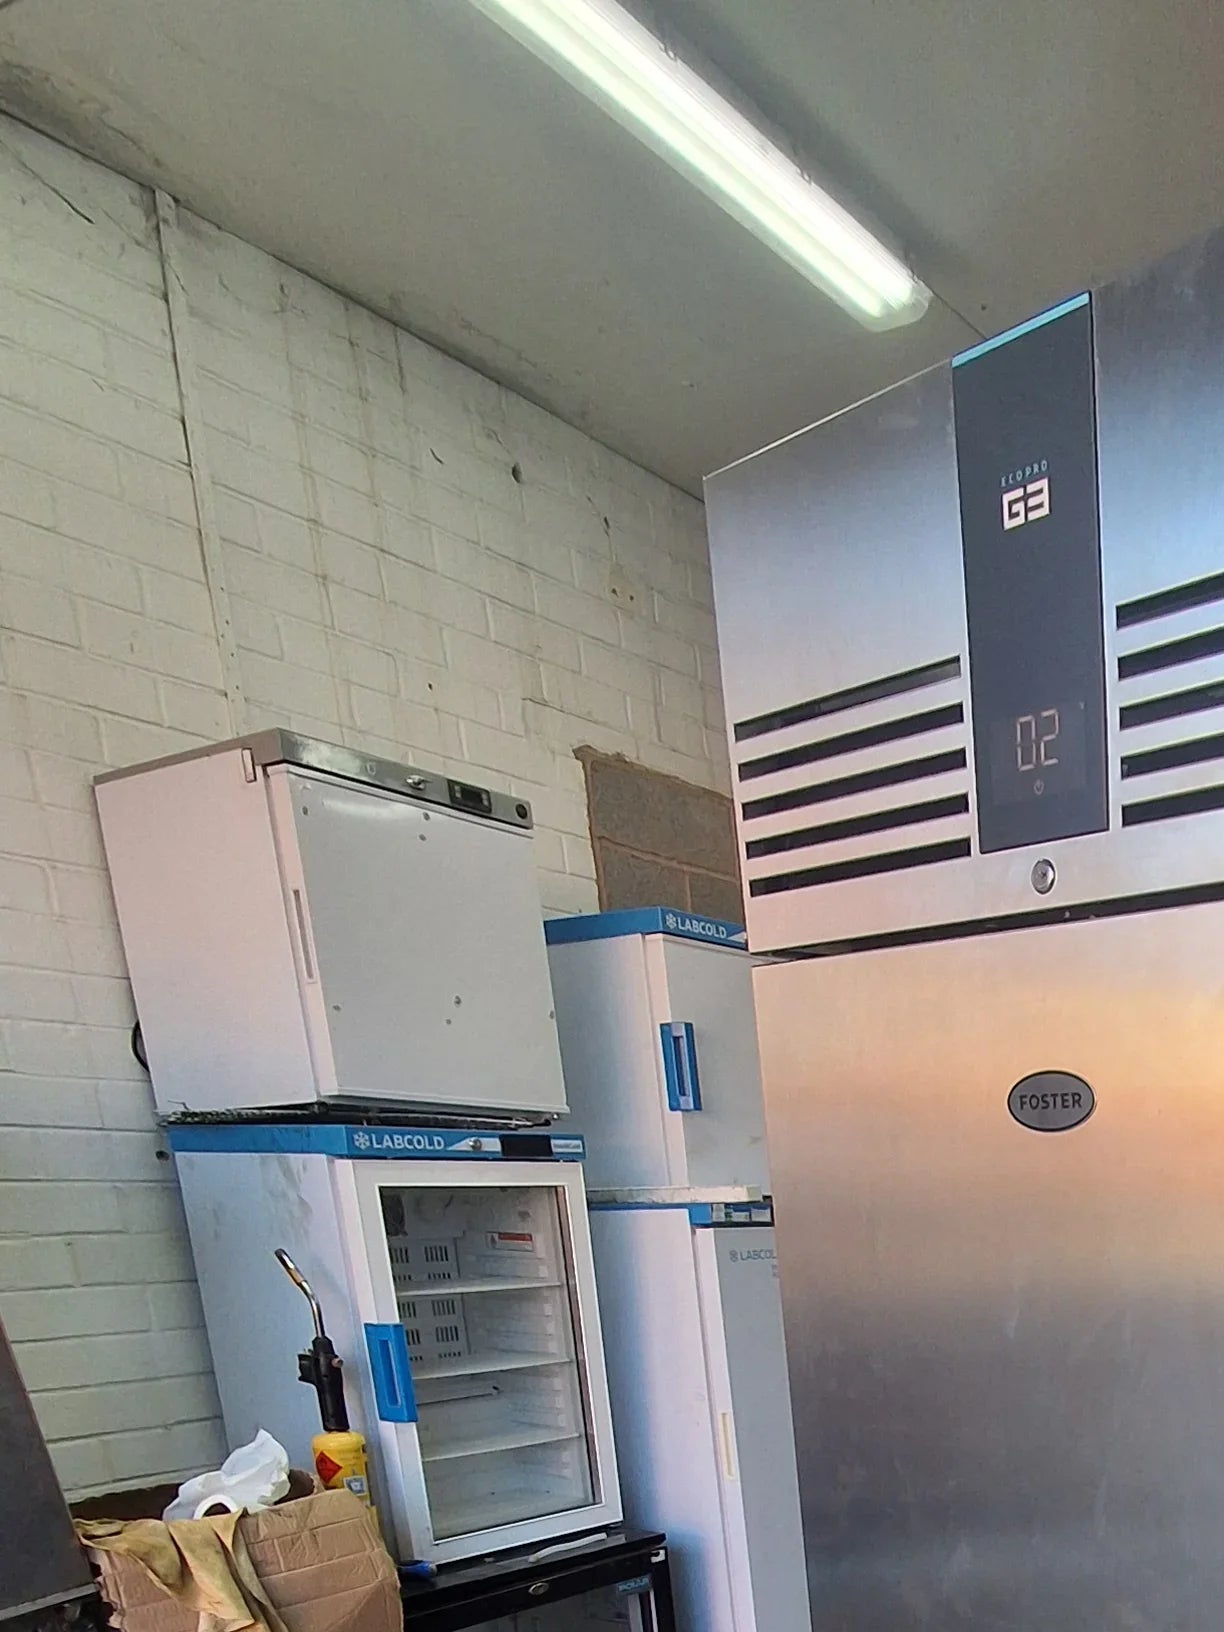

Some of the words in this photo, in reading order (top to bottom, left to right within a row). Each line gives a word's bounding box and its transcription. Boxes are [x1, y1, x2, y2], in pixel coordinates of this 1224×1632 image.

[1001, 459, 1049, 488] ECOPRO
[1002, 477, 1050, 531] G3
[1016, 708, 1060, 772] 02
[677, 917, 728, 939] LABCOLD
[1019, 1092, 1082, 1110] FOSTER
[371, 1133, 445, 1151] LABCOLD
[740, 1249, 777, 1261] LABCOL
